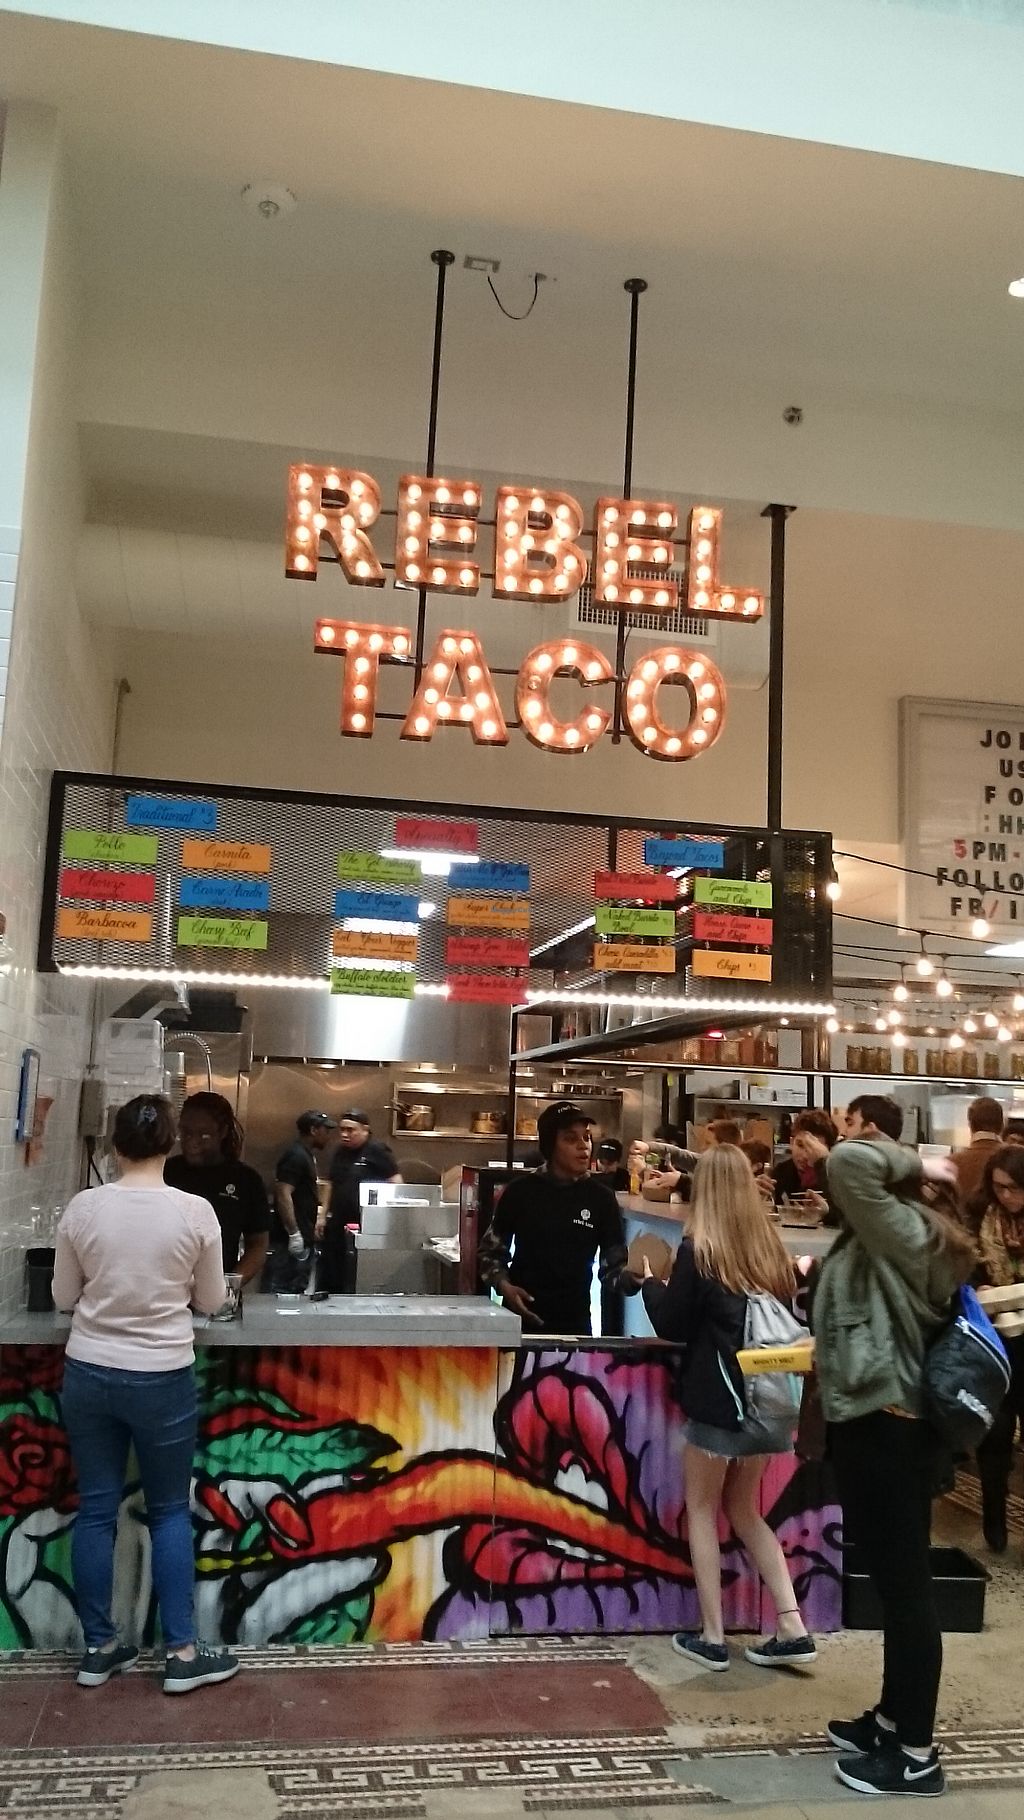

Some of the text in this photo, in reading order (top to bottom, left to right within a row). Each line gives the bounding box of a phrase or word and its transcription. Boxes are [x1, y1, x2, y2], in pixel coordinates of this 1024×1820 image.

[285, 464, 765, 623] REBEL
[314, 618, 727, 762] TACO
[75, 911, 137, 929] Barbacoa
